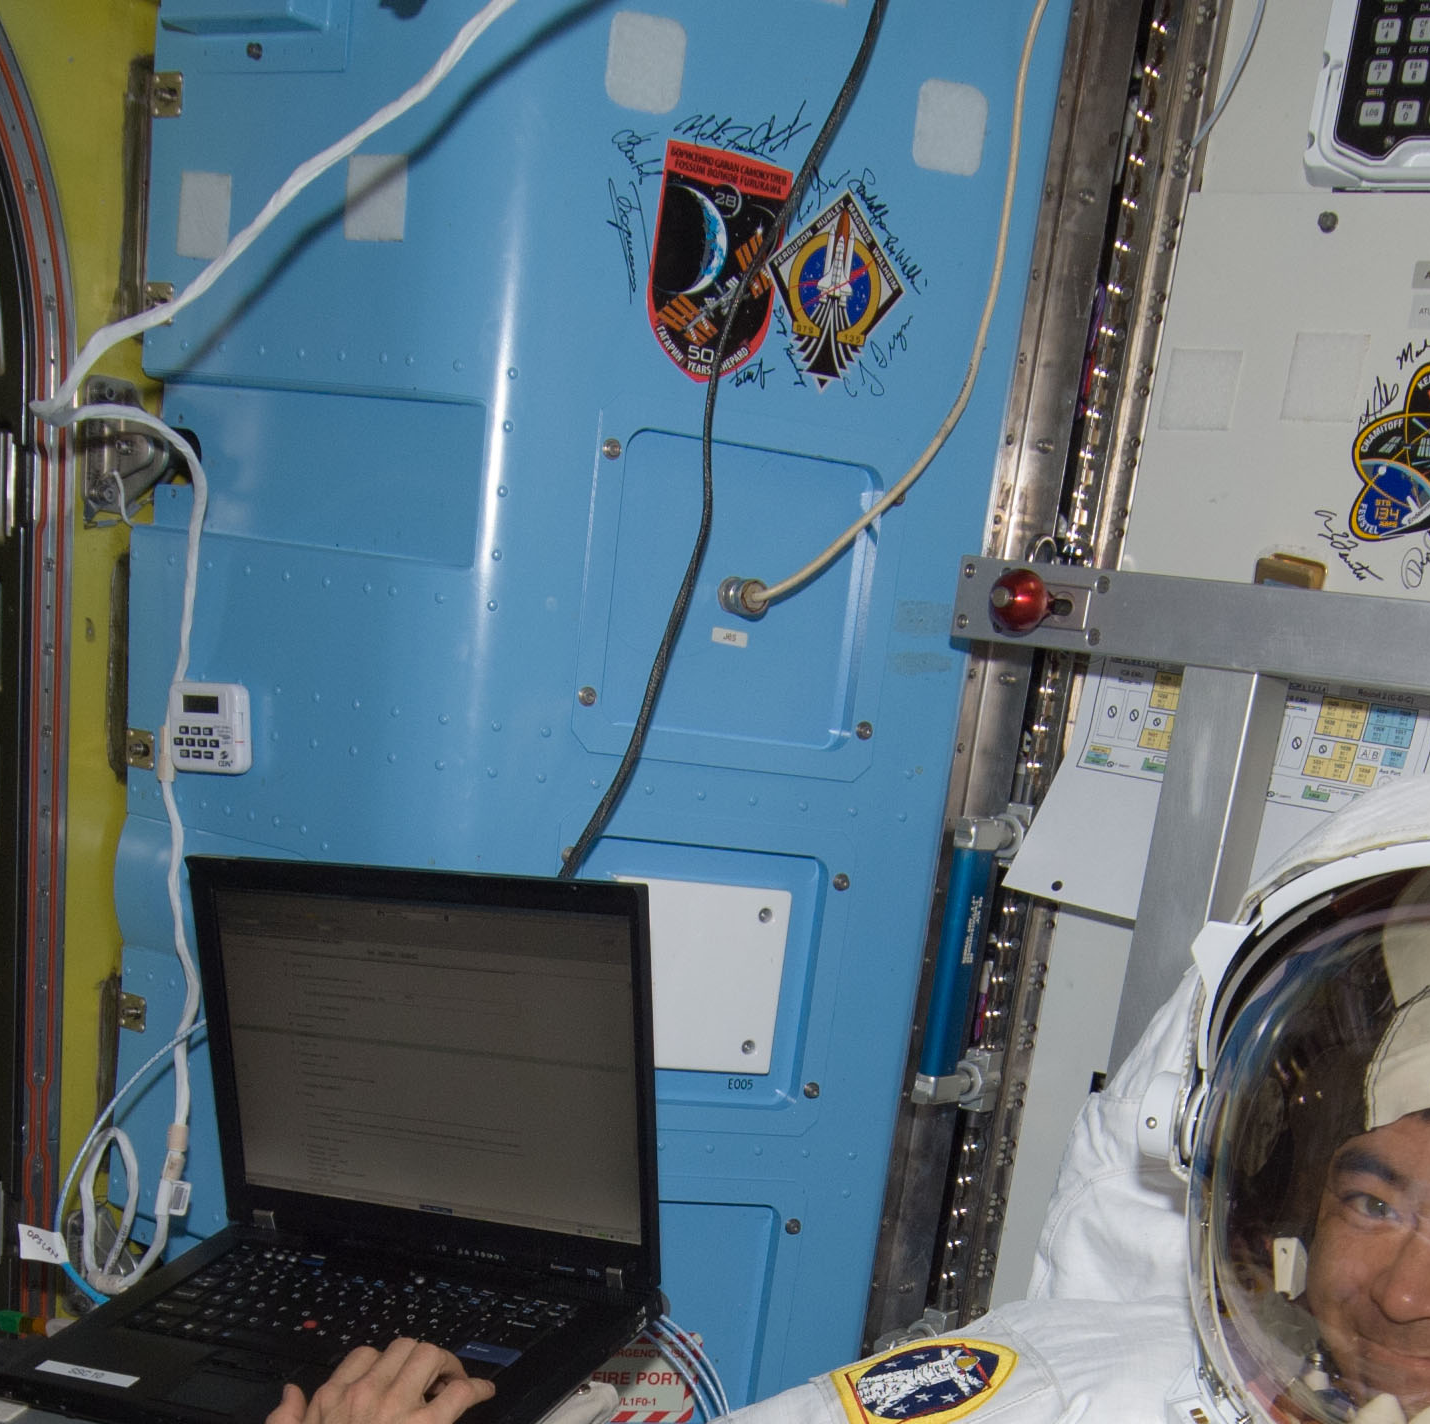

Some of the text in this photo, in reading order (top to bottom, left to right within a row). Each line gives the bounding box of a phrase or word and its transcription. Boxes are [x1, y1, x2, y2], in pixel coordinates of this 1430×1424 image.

[674, 160, 706, 176] FOSSUM
[740, 177, 782, 196] FURUKAWA
[714, 191, 736, 208] 28
[816, 201, 845, 229] HURLEY
[847, 202, 873, 243] MAGNUS
[774, 231, 813, 267] FERGUSON
[872, 247, 898, 290] WALHEIM
[656, 326, 684, 361] ГАГАРИН
[843, 334, 861, 344] 135
[688, 346, 714, 363] 50
[721, 346, 749, 371] HEPARD
[687, 361, 712, 375] YEARS
[1360, 419, 1404, 452] CHAMITOFF
[1358, 503, 1378, 534] FEUSTEL
[1374, 508, 1399, 519] 134
[1372, 751, 1378, 760] B
[728, 1078, 753, 1090] E005
[27, 1229, 42, 1244] OPS
[593, 1372, 682, 1385] FIRE PORT
[618, 1398, 657, 1406] /L1F0-1
